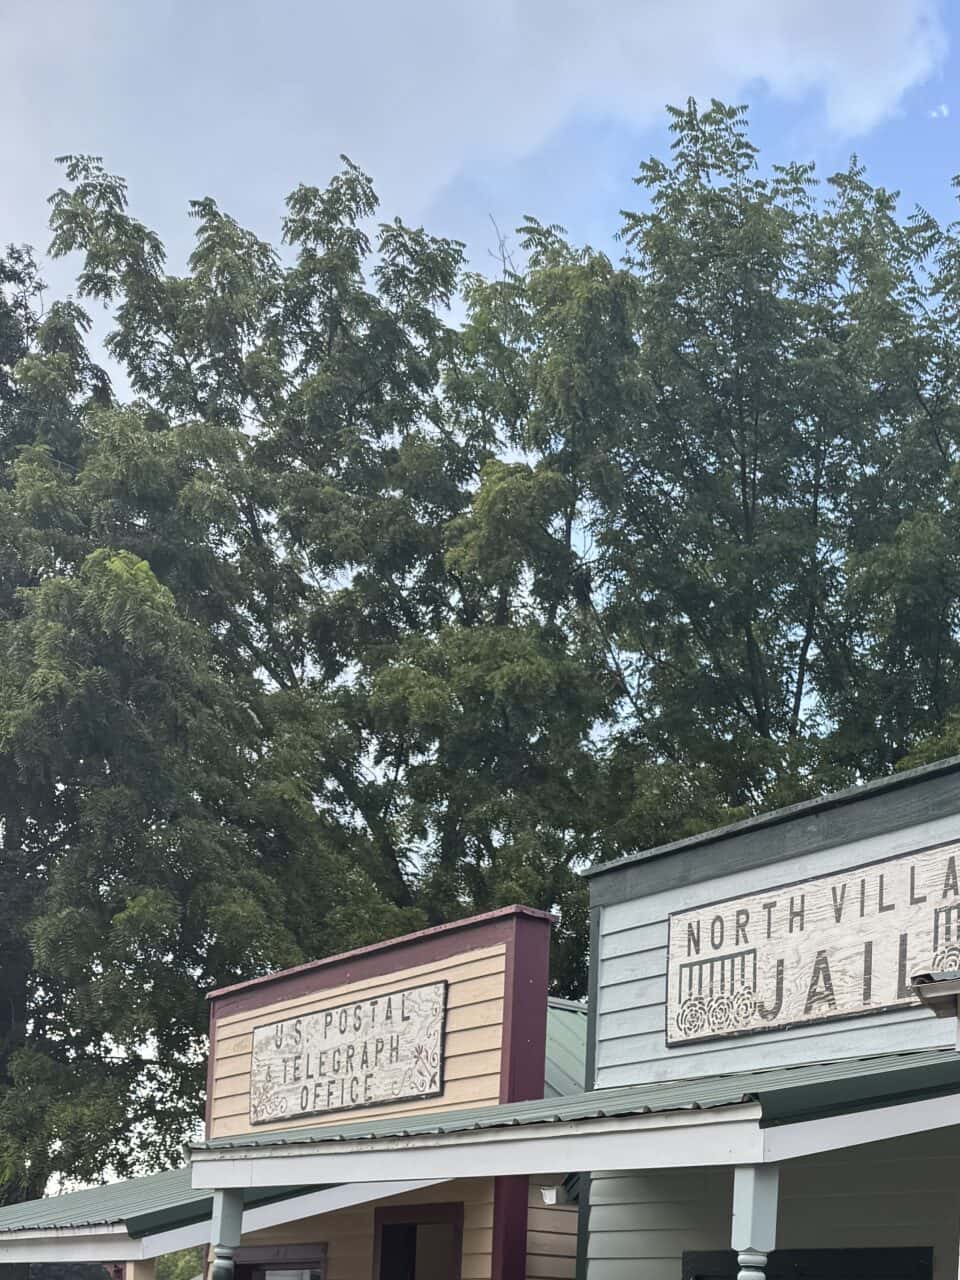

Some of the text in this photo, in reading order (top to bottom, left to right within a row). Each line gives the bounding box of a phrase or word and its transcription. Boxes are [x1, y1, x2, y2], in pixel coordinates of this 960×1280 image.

[687, 893, 805, 957] NORTH
[757, 932, 914, 1020] JAIL
[324, 993, 411, 1039] POSTAL
[282, 1034, 400, 1084] TELEGRAPH
[299, 1073, 375, 1111] OFFICE
